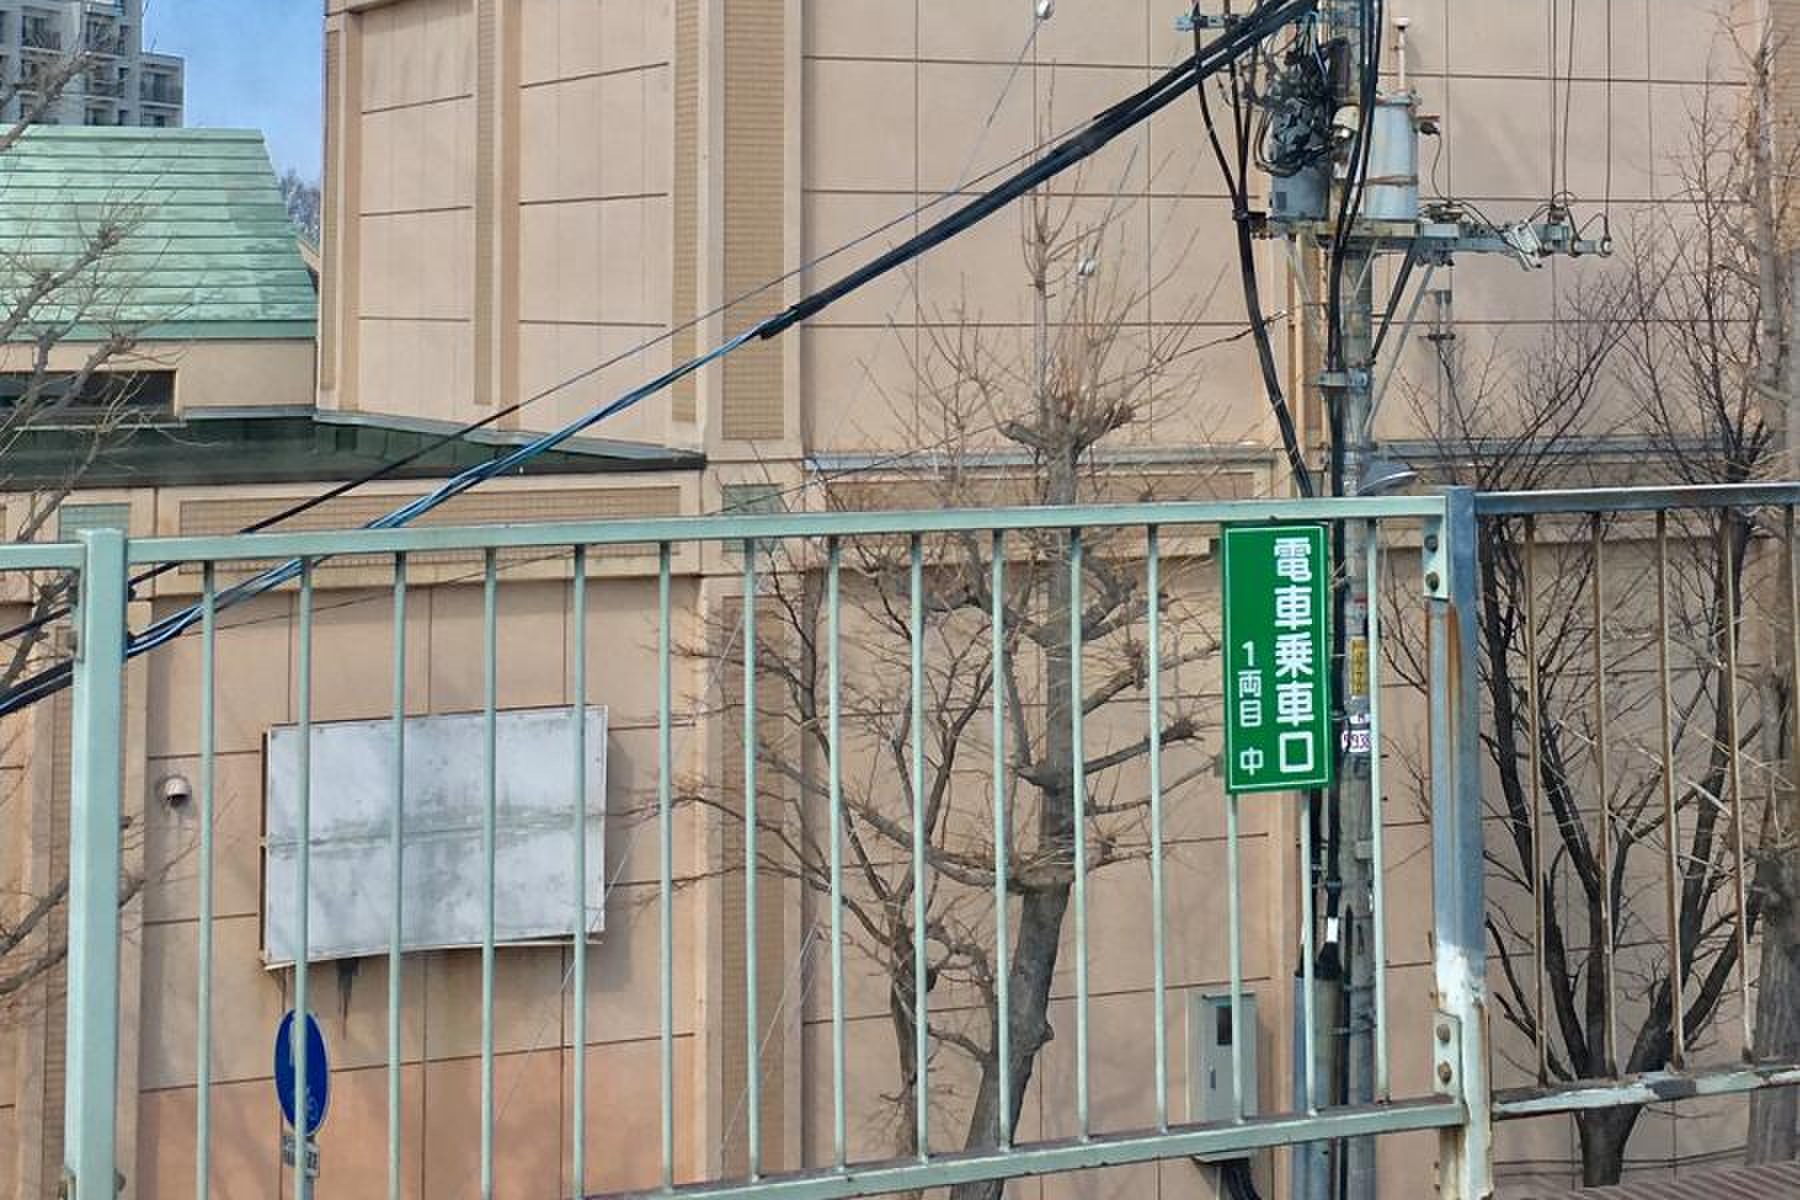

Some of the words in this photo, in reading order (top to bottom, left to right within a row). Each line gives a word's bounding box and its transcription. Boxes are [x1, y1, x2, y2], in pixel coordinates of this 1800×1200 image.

[1274, 537, 1314, 773] 電車乗車口
[1240, 747, 1264, 775] 中
